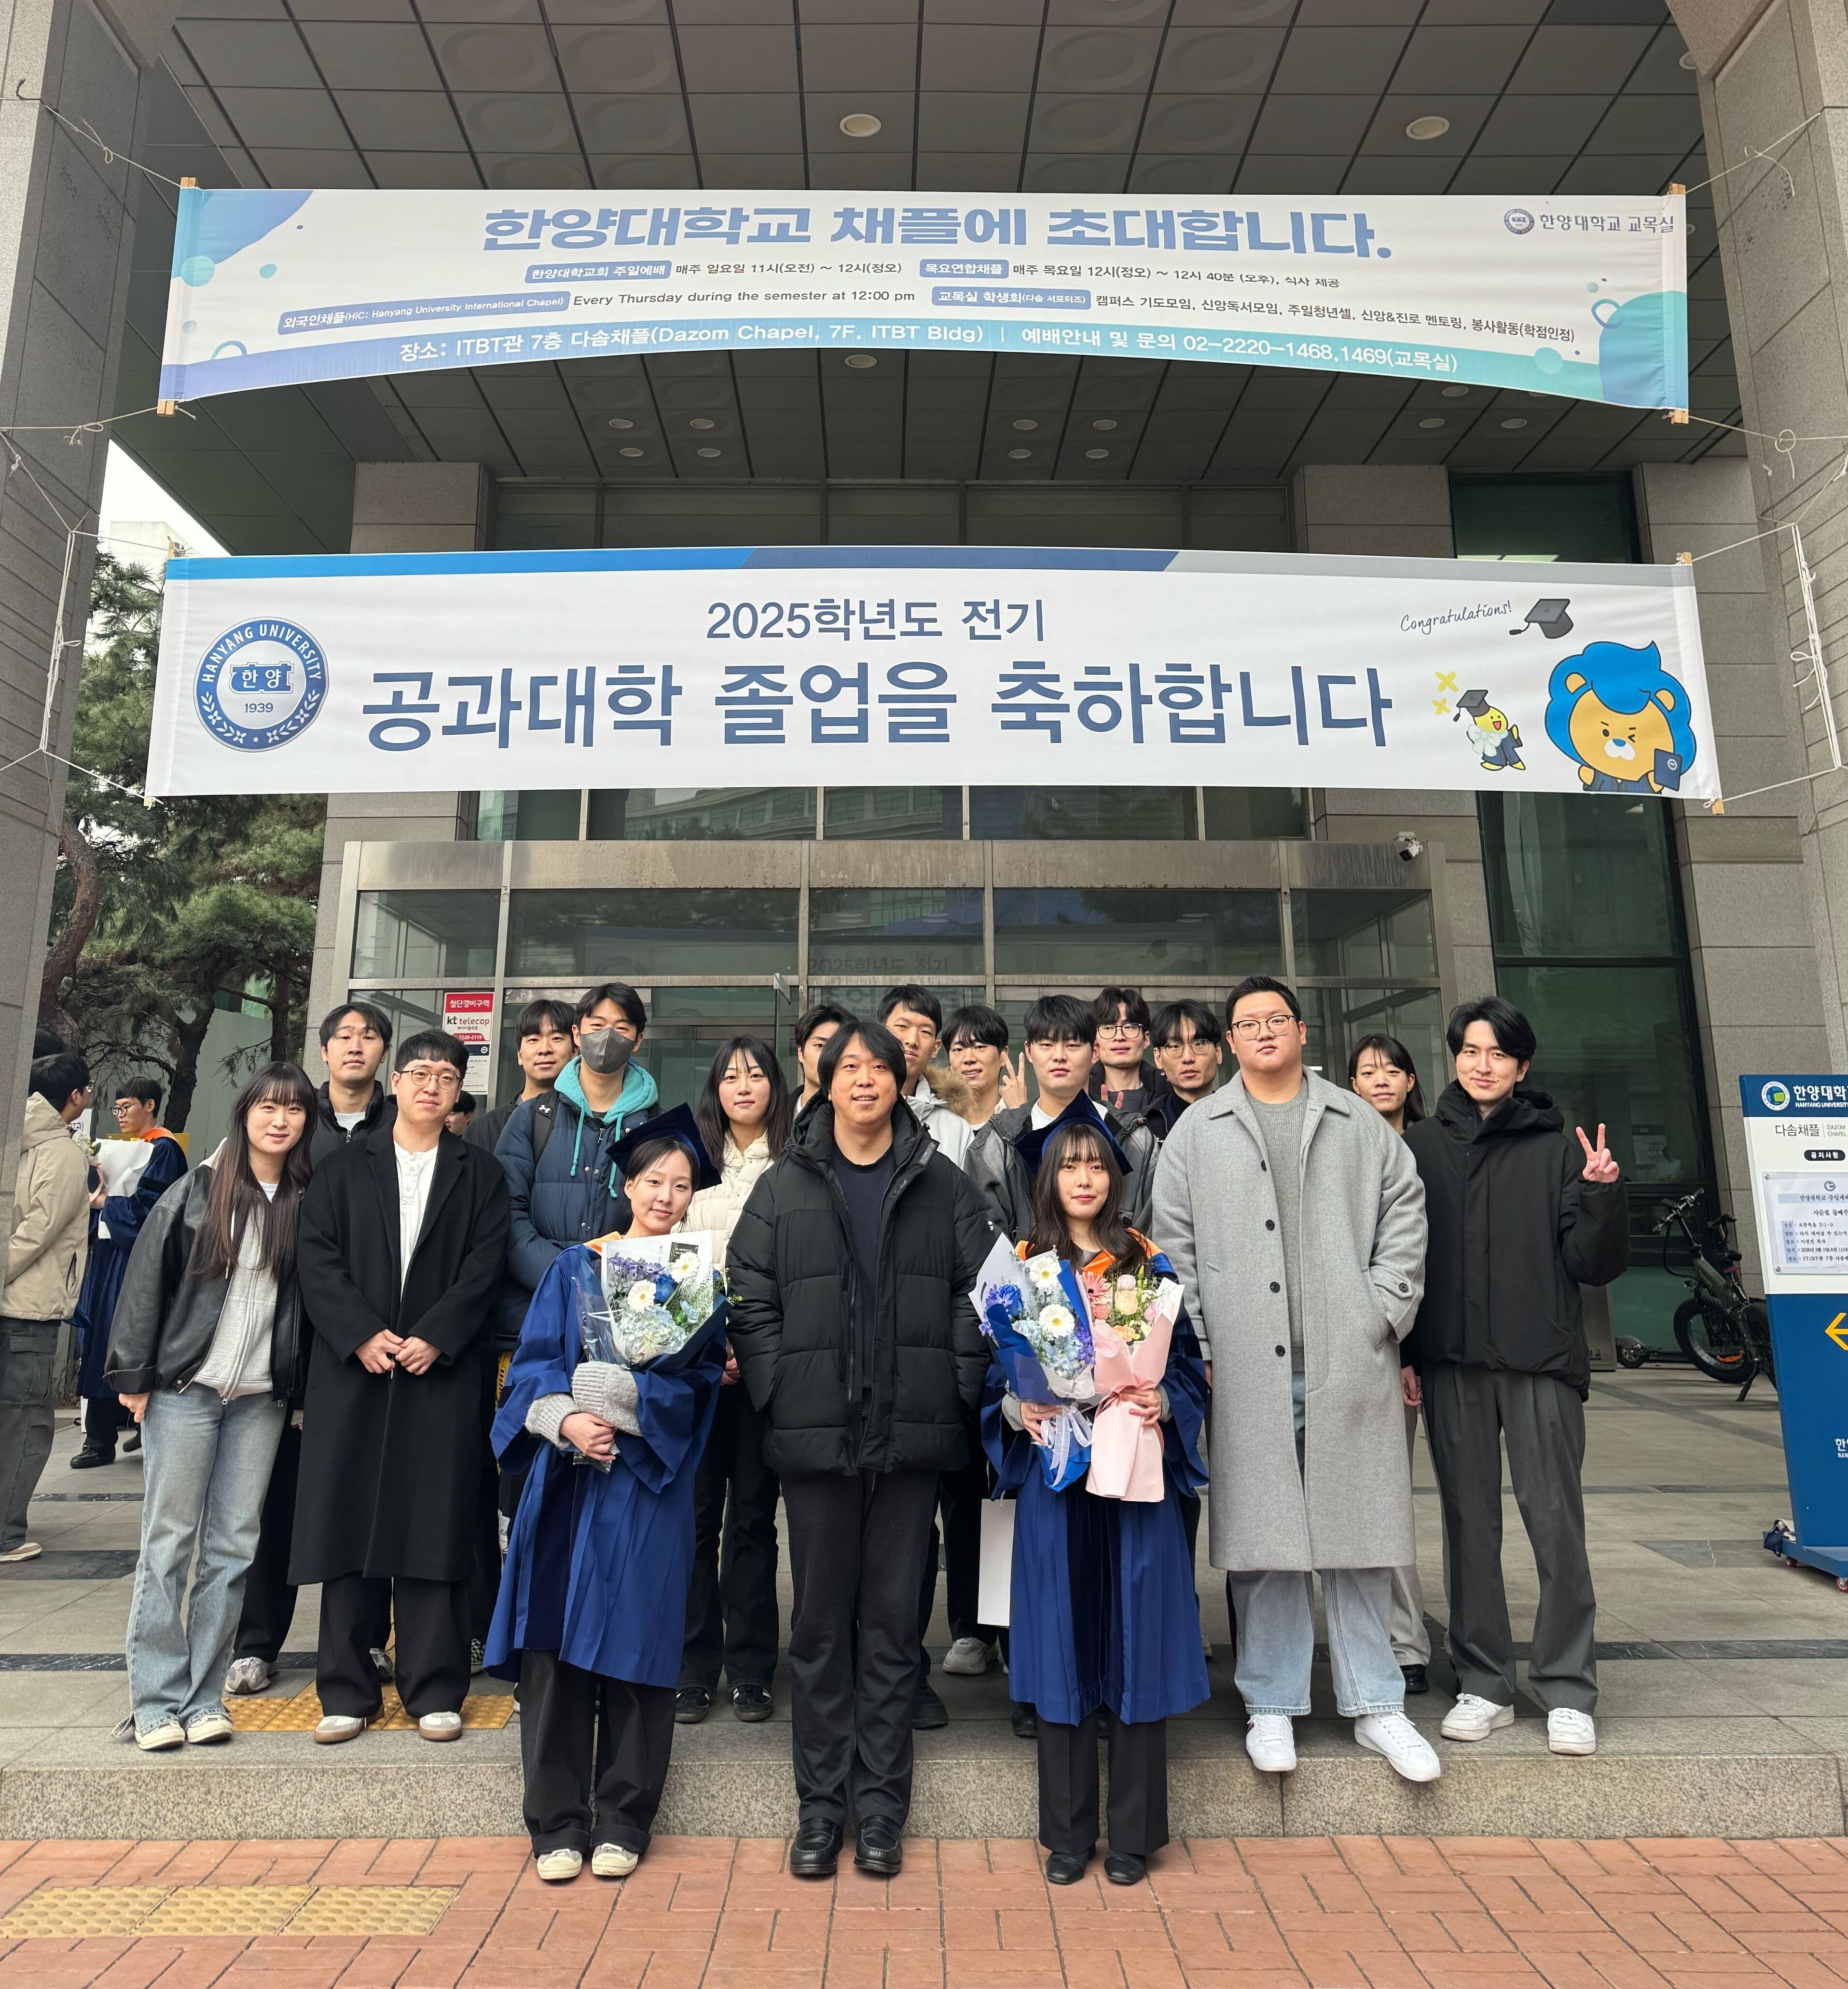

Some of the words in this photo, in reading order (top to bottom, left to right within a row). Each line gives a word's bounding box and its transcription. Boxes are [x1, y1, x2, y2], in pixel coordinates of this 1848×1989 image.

[483, 207, 811, 250] 한양대학교
[831, 207, 1026, 245] 채플에
[1048, 208, 1392, 259] 초대합니다.
[1539, 215, 1621, 232] 한양대학교
[1628, 216, 1674, 233] 교목실
[532, 266, 608, 279] 한양대학교회
[613, 265, 666, 276] 주일예배
[676, 264, 701, 274] 매주
[707, 264, 745, 274] 일요일
[751, 263, 815, 274] 11시(오전)
[839, 263, 902, 274] 12시(정오)
[925, 263, 1003, 275] 목요연합채플
[1013, 265, 1038, 275] 매주
[1044, 265, 1081, 276] 목요일
[1088, 266, 1151, 278] 12시(정오)
[1174, 271, 1201, 281] 12시
[1206, 273, 1235, 282] 40분
[1240, 273, 1279, 285] (오후),
[1285, 276, 1310, 286] 식사
[1315, 278, 1340, 288] 제공
[574, 295, 613, 306] Every
[619, 293, 682, 304] Thursday
[688, 292, 732, 302] during
[738, 291, 759, 301] the
[764, 291, 827, 301] semester
[832, 291, 846, 300] at
[852, 291, 889, 301] 12:00
[895, 294, 915, 302] pm
[938, 291, 978, 303] 교목실
[983, 291, 1044, 304] 학생회(다솜
[1047, 295, 1086, 304] 서포터즈)
[283, 311, 368, 329] 외국인채플(HIC:
[372, 307, 412, 318] Hanyang
[415, 304, 461, 315] University
[465, 300, 524, 311] International
[526, 297, 564, 307] Chapel)
[1096, 295, 1135, 307] 캠퍼스
[1140, 297, 1195, 311] 기도모임,
[1201, 299, 1282, 315] 신앙독서모임,
[1288, 304, 1355, 321] 주일청년셀,
[1361, 310, 1421, 325] 신앙&진로
[1426, 315, 1466, 330] 멘토링,
[1472, 318, 1574, 343] 봉사활동(학점인정)
[400, 342, 446, 362] 장소:
[456, 334, 524, 356] ITBT관
[531, 332, 563, 350] 7층
[571, 325, 729, 347] 다솜채플(Dazom
[738, 325, 819, 341] Chapel,
[829, 325, 861, 341] 7F,
[872, 325, 920, 339] ITBT
[928, 325, 983, 343] Bldg)
[1022, 328, 1101, 346] 예배안내
[1109, 331, 1128, 348] 및
[1136, 333, 1175, 351] 문의
[707, 599, 942, 641] 2025학년도
[962, 599, 1044, 641] 전기
[1401, 600, 1512, 635] Congratulations!
[202, 627, 253, 682] HANYANG
[259, 624, 321, 679] UNIVERSITY
[242, 669, 281, 688] 한양
[245, 702, 274, 713] 1939
[363, 665, 682, 751] 공과대학
[715, 662, 956, 745] 졸업을
[991, 661, 1393, 747] 축하합니다
[450, 1000, 490, 1008] 첨단경비구역
[447, 1016, 457, 1025] kt
[459, 1017, 489, 1026] telecop
[1793, 1085, 1848, 1101] 한양대학
[1775, 1124, 1820, 1137] 다솜채플
